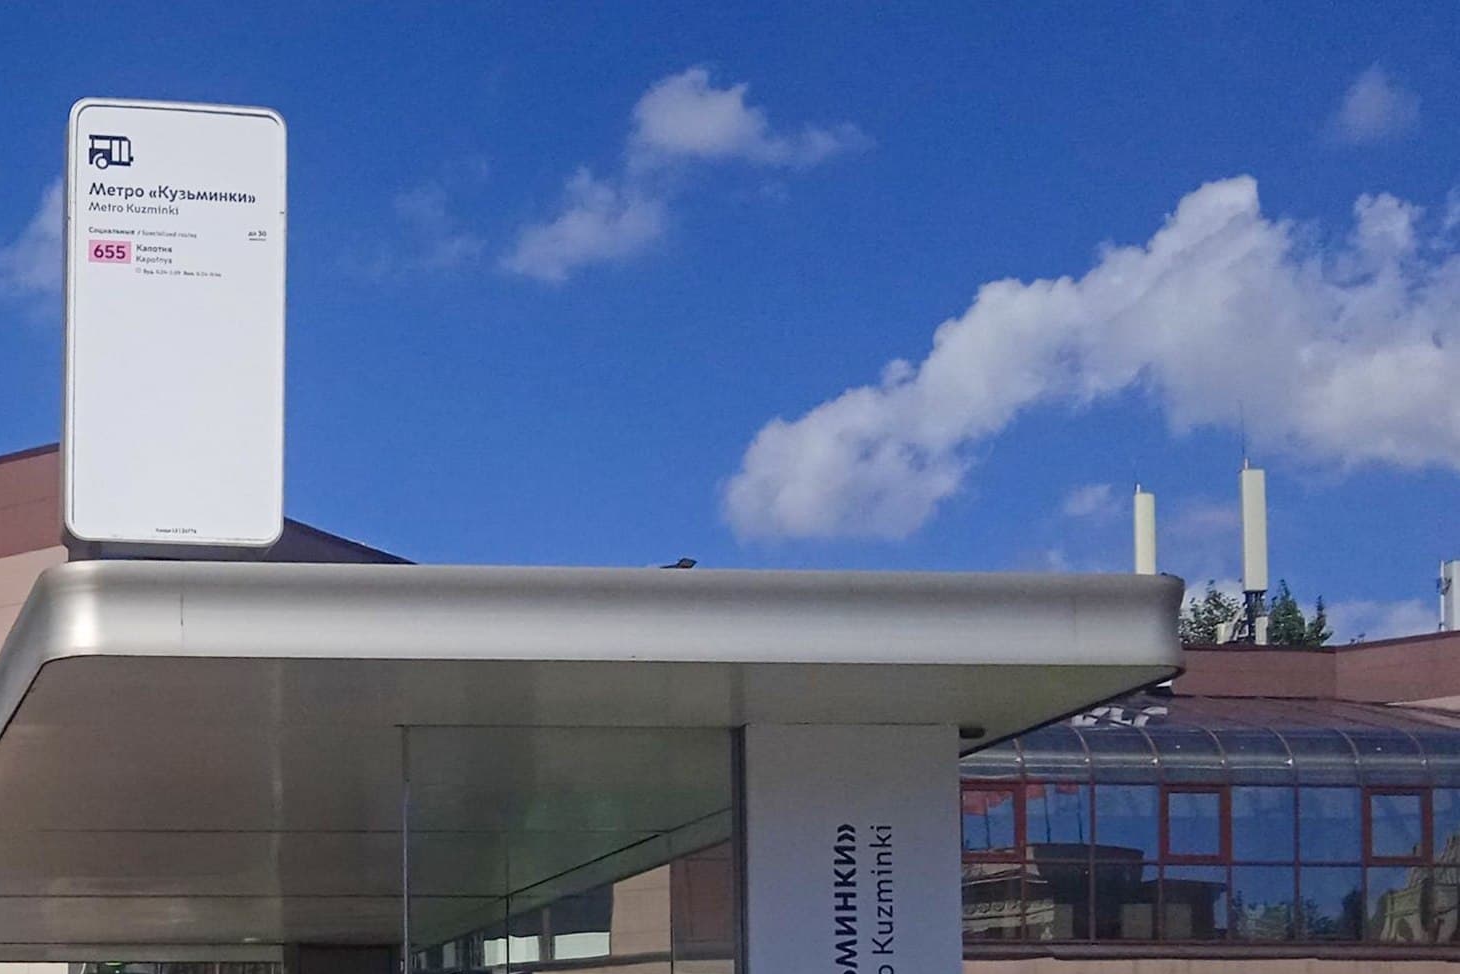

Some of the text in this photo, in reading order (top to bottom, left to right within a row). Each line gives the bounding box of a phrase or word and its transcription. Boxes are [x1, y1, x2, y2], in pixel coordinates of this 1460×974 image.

[89, 183, 256, 204] Метро «Кузьминки»
[88, 202, 179, 216] Metro Kuzminki
[93, 244, 126, 260] 655
[136, 244, 173, 254] Капотня
[869, 825, 895, 955] Kuzminki
